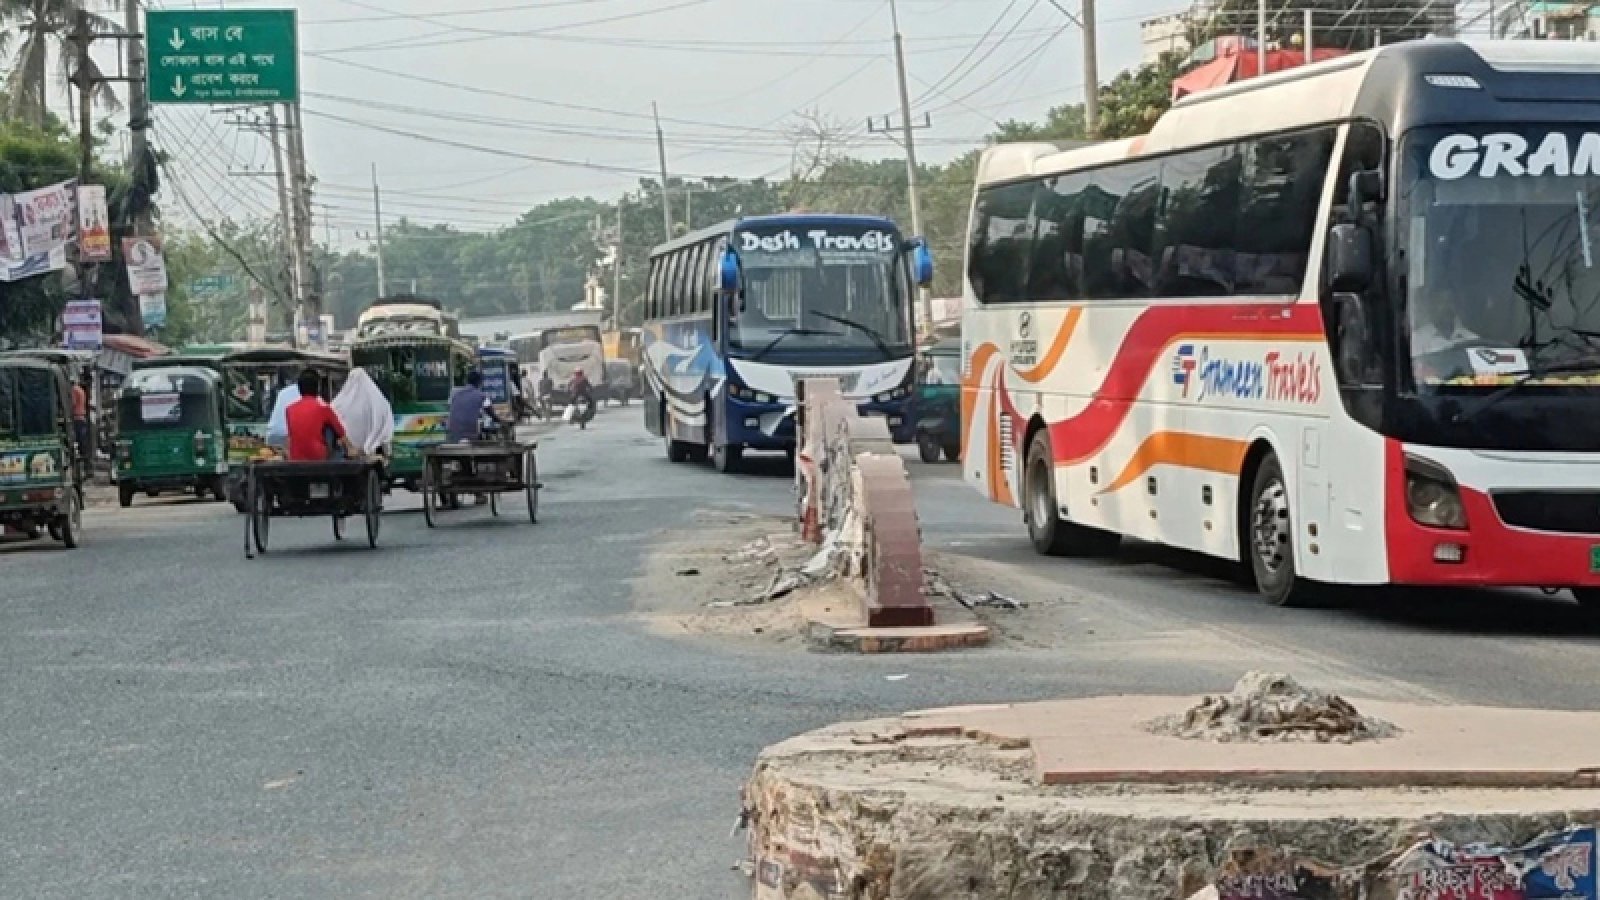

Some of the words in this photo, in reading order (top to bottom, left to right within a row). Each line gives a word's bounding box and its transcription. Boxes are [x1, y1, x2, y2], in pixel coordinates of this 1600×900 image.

[190, 26, 219, 41] বাস
[224, 26, 243, 42] বে
[160, 55, 199, 67] লোকাল
[204, 55, 225, 66] বাস
[228, 52, 247, 67] এই
[252, 54, 275, 66] পথে
[190, 73, 223, 86] প্রবেশ
[229, 73, 259, 85] করবে
[740, 229, 800, 252] Desh
[807, 229, 895, 252] Travels
[1197, 345, 1264, 402] Grameen
[1265, 351, 1321, 403] Travels
